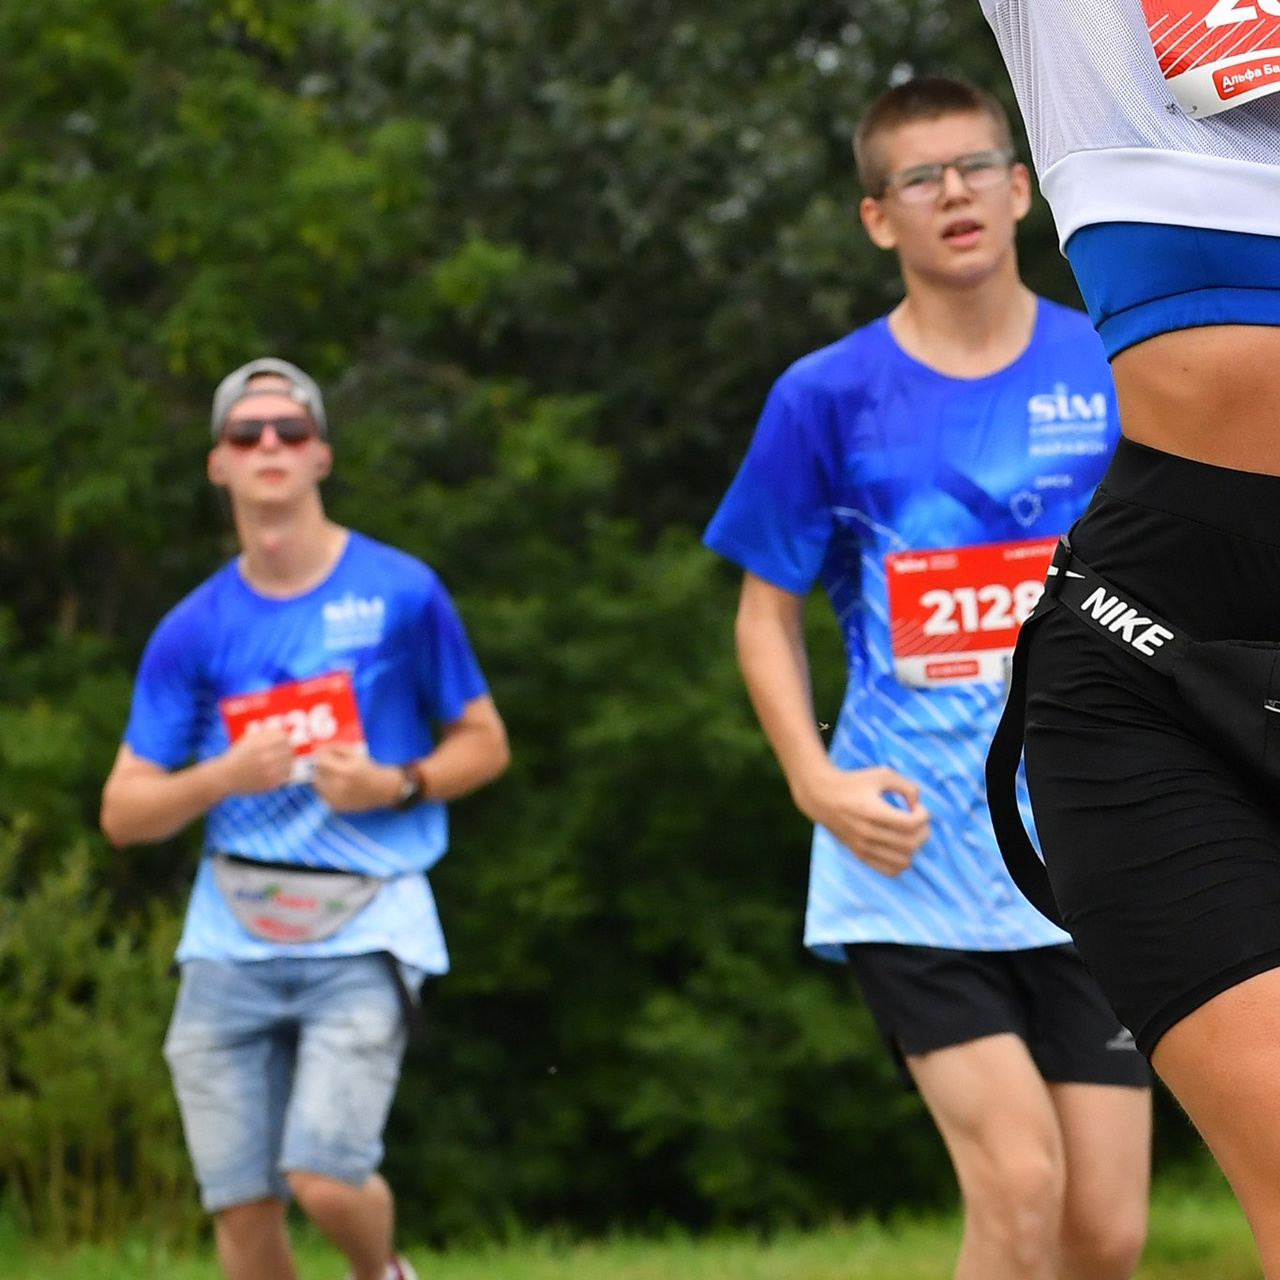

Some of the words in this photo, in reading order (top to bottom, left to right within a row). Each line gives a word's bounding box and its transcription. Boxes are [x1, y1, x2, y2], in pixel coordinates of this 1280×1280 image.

[1222, 68, 1262, 93] Альфа
[919, 579, 1045, 636] 2128
[1080, 586, 1174, 656] NIKE
